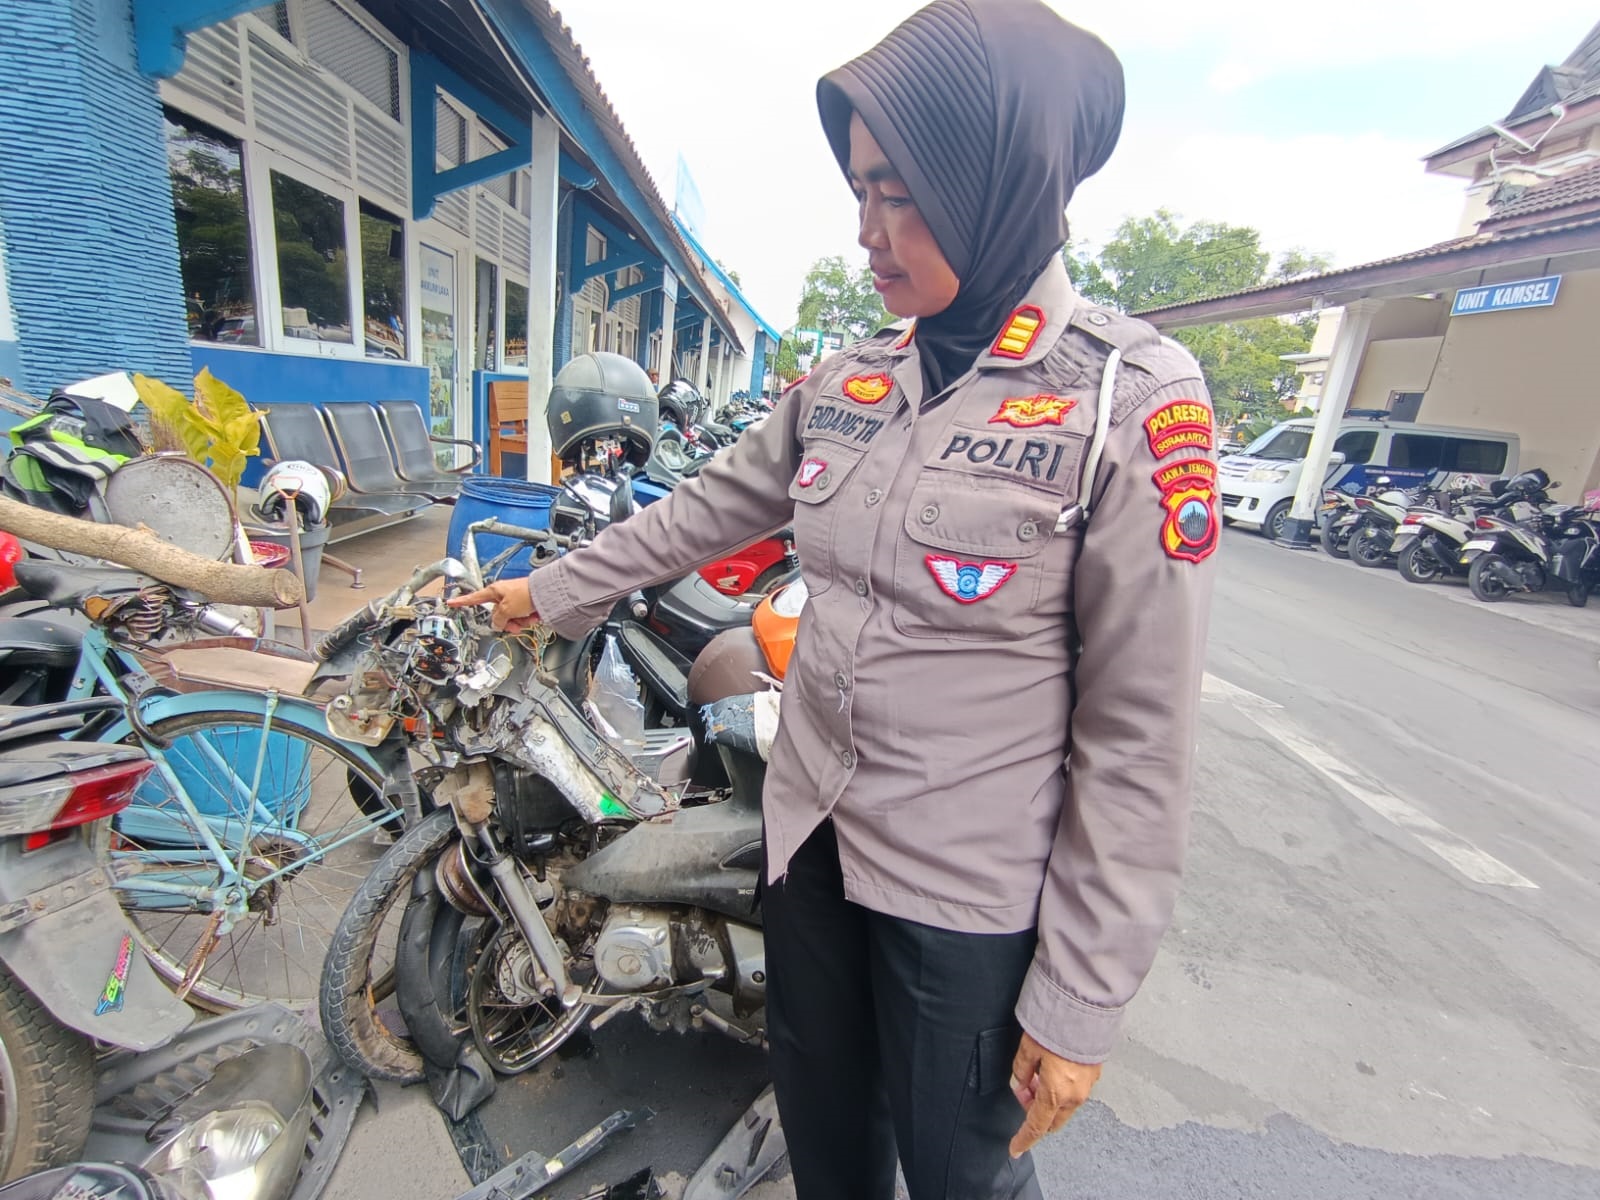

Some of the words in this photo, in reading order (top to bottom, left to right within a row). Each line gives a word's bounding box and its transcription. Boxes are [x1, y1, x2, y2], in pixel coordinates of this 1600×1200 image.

[1457, 291, 1490, 311] UNIT
[1491, 282, 1551, 307] KAMSEL
[807, 405, 864, 436] ENDANG
[854, 417, 884, 444] TH
[1149, 404, 1209, 436] POLRESTA
[1157, 432, 1208, 452] SURAKARTA
[940, 434, 1064, 481] POLRI
[1161, 466, 1184, 484] JAWA
